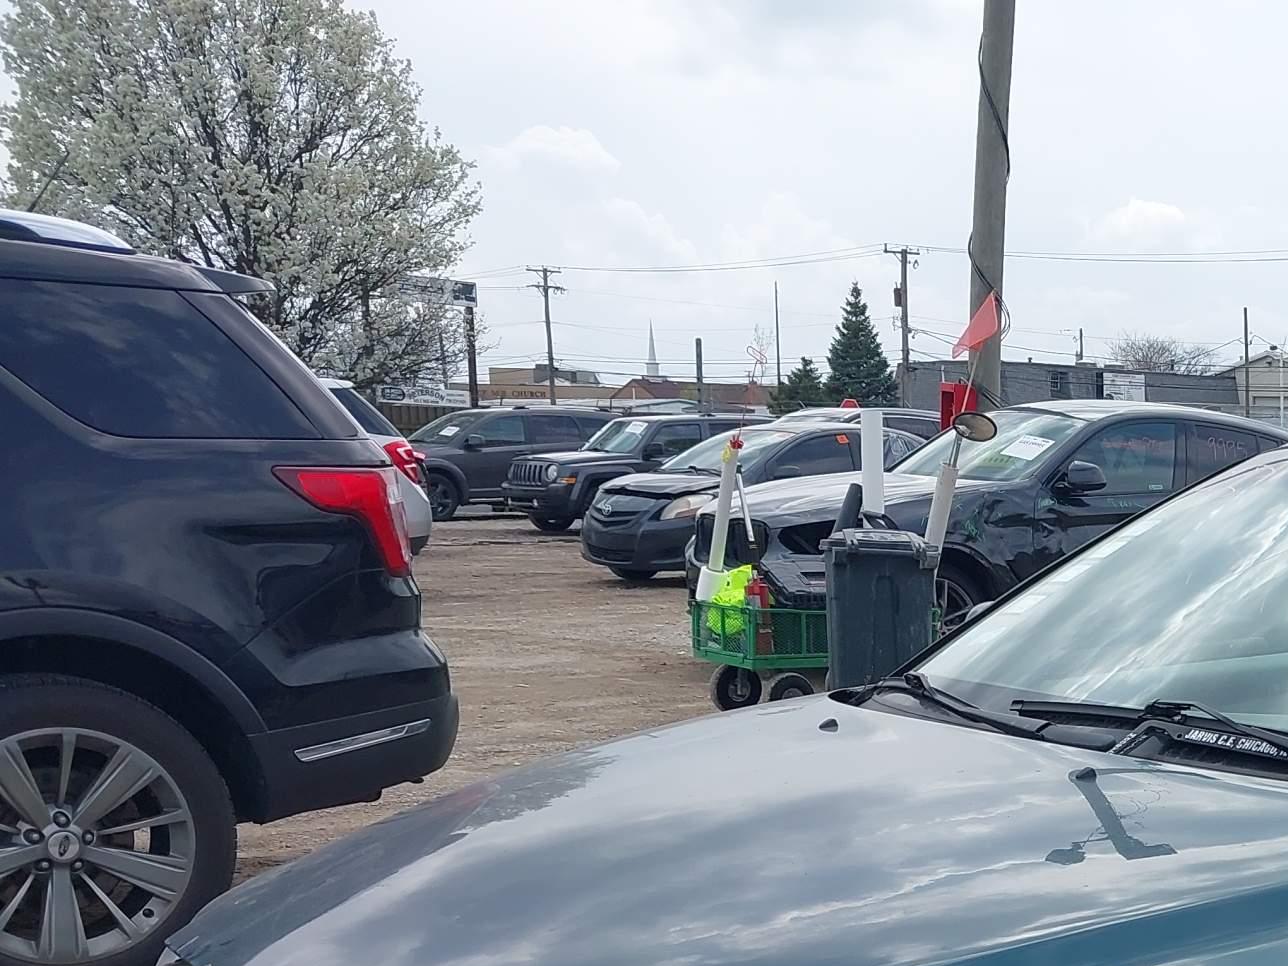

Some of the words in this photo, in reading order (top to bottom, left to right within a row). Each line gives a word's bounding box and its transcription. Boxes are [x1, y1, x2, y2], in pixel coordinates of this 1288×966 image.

[512, 390, 546, 398] CHURCH
[1207, 437, 1248, 462] 9995
[1185, 729, 1217, 745] JARVIS
